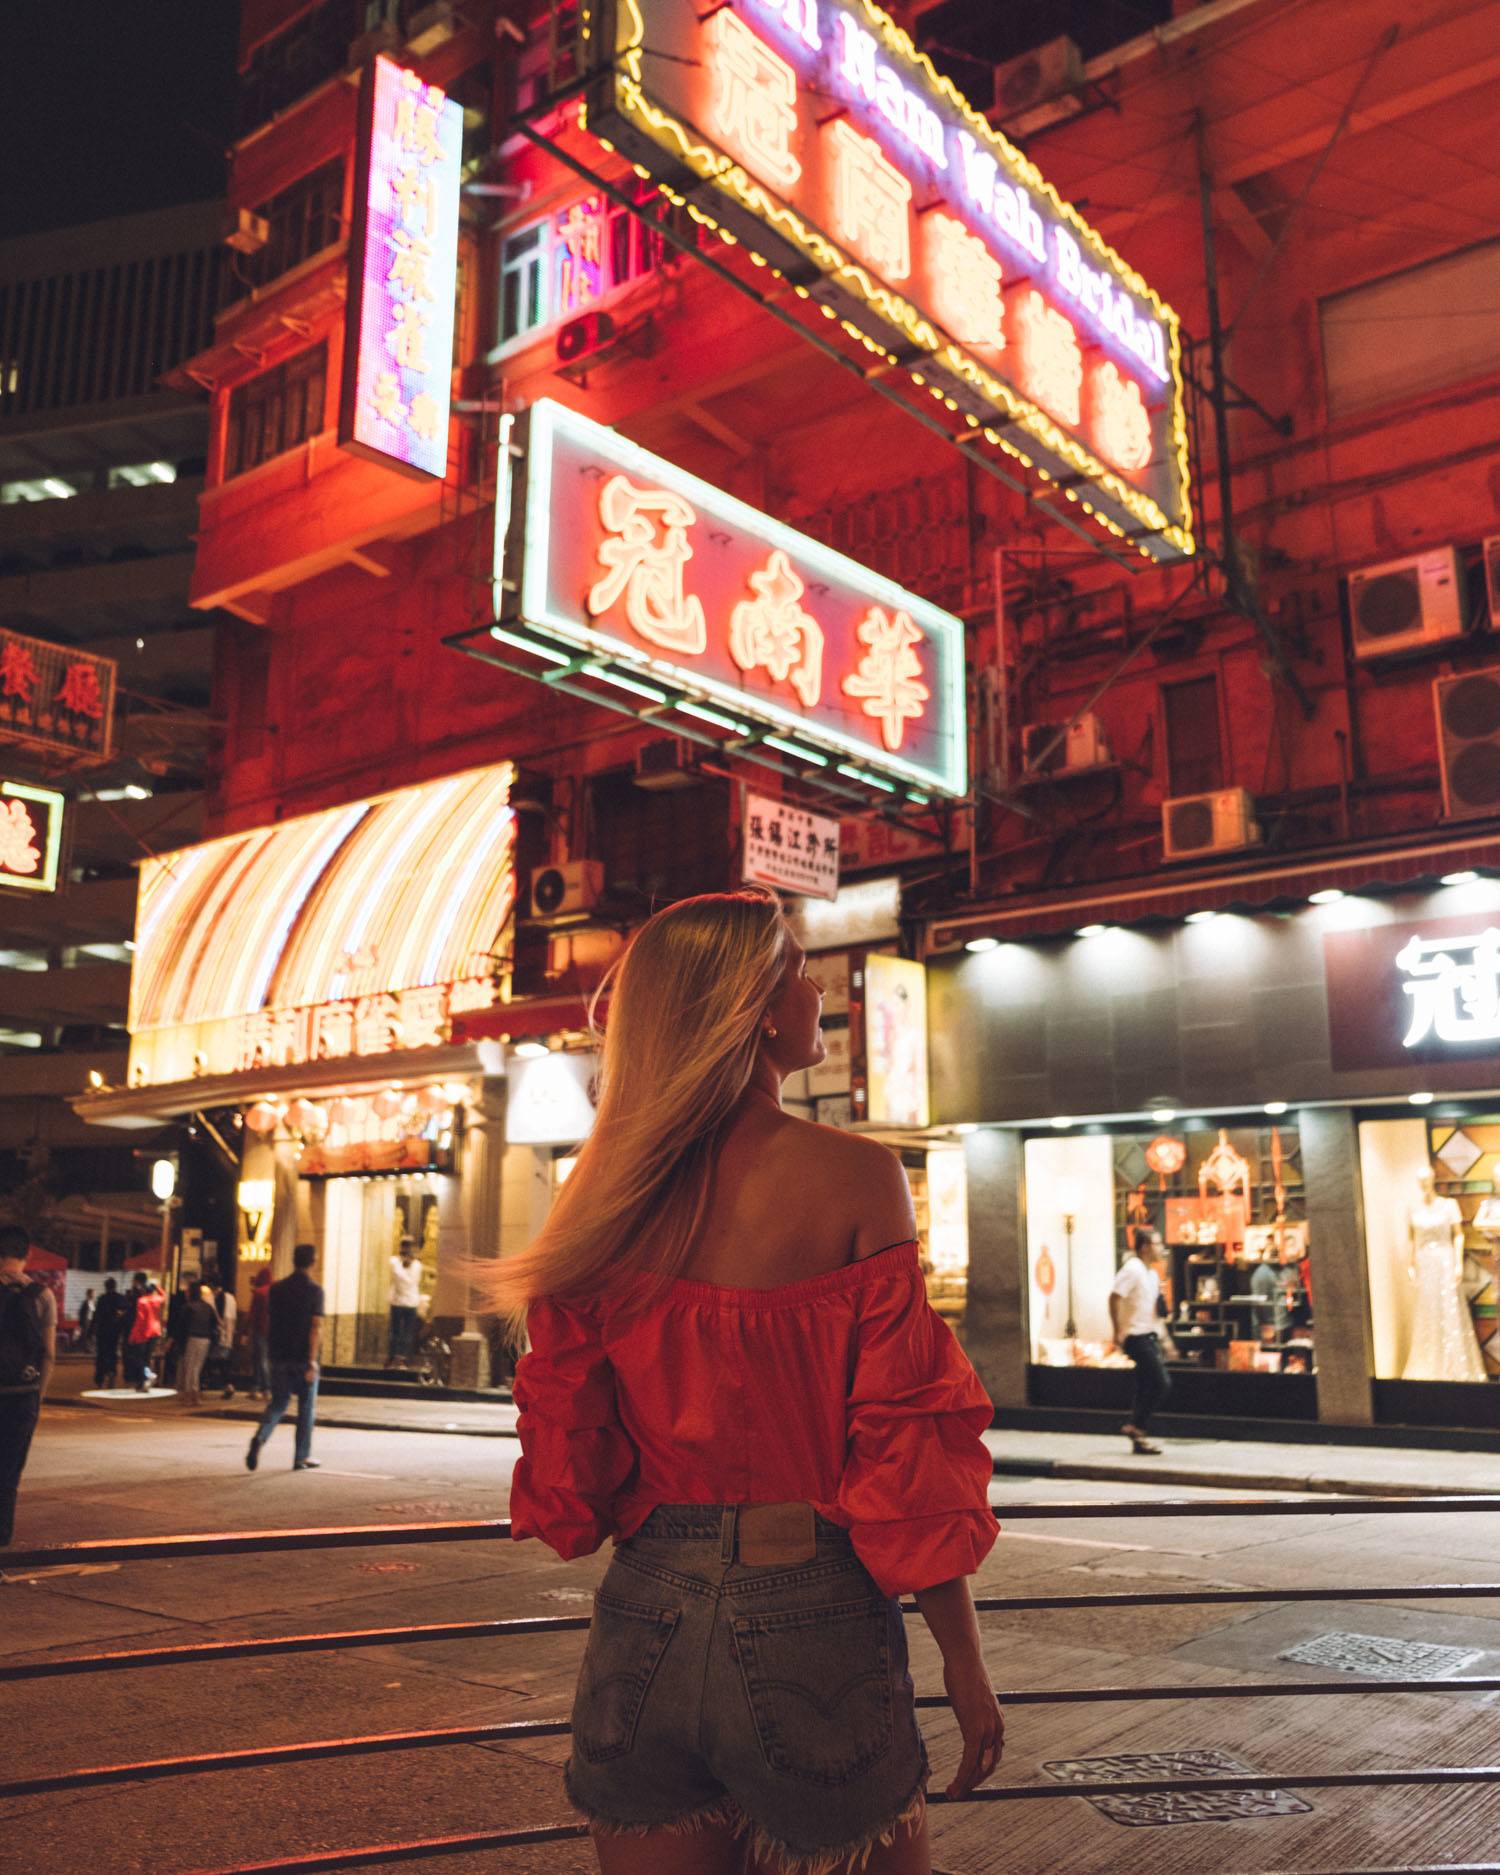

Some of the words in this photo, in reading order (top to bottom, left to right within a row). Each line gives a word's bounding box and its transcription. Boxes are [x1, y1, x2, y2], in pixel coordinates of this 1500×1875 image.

[840, 13, 949, 169] Nam
[957, 129, 1049, 265] Wah
[1053, 225, 1170, 383] Bridal
[588, 474, 930, 750] 冠南華
